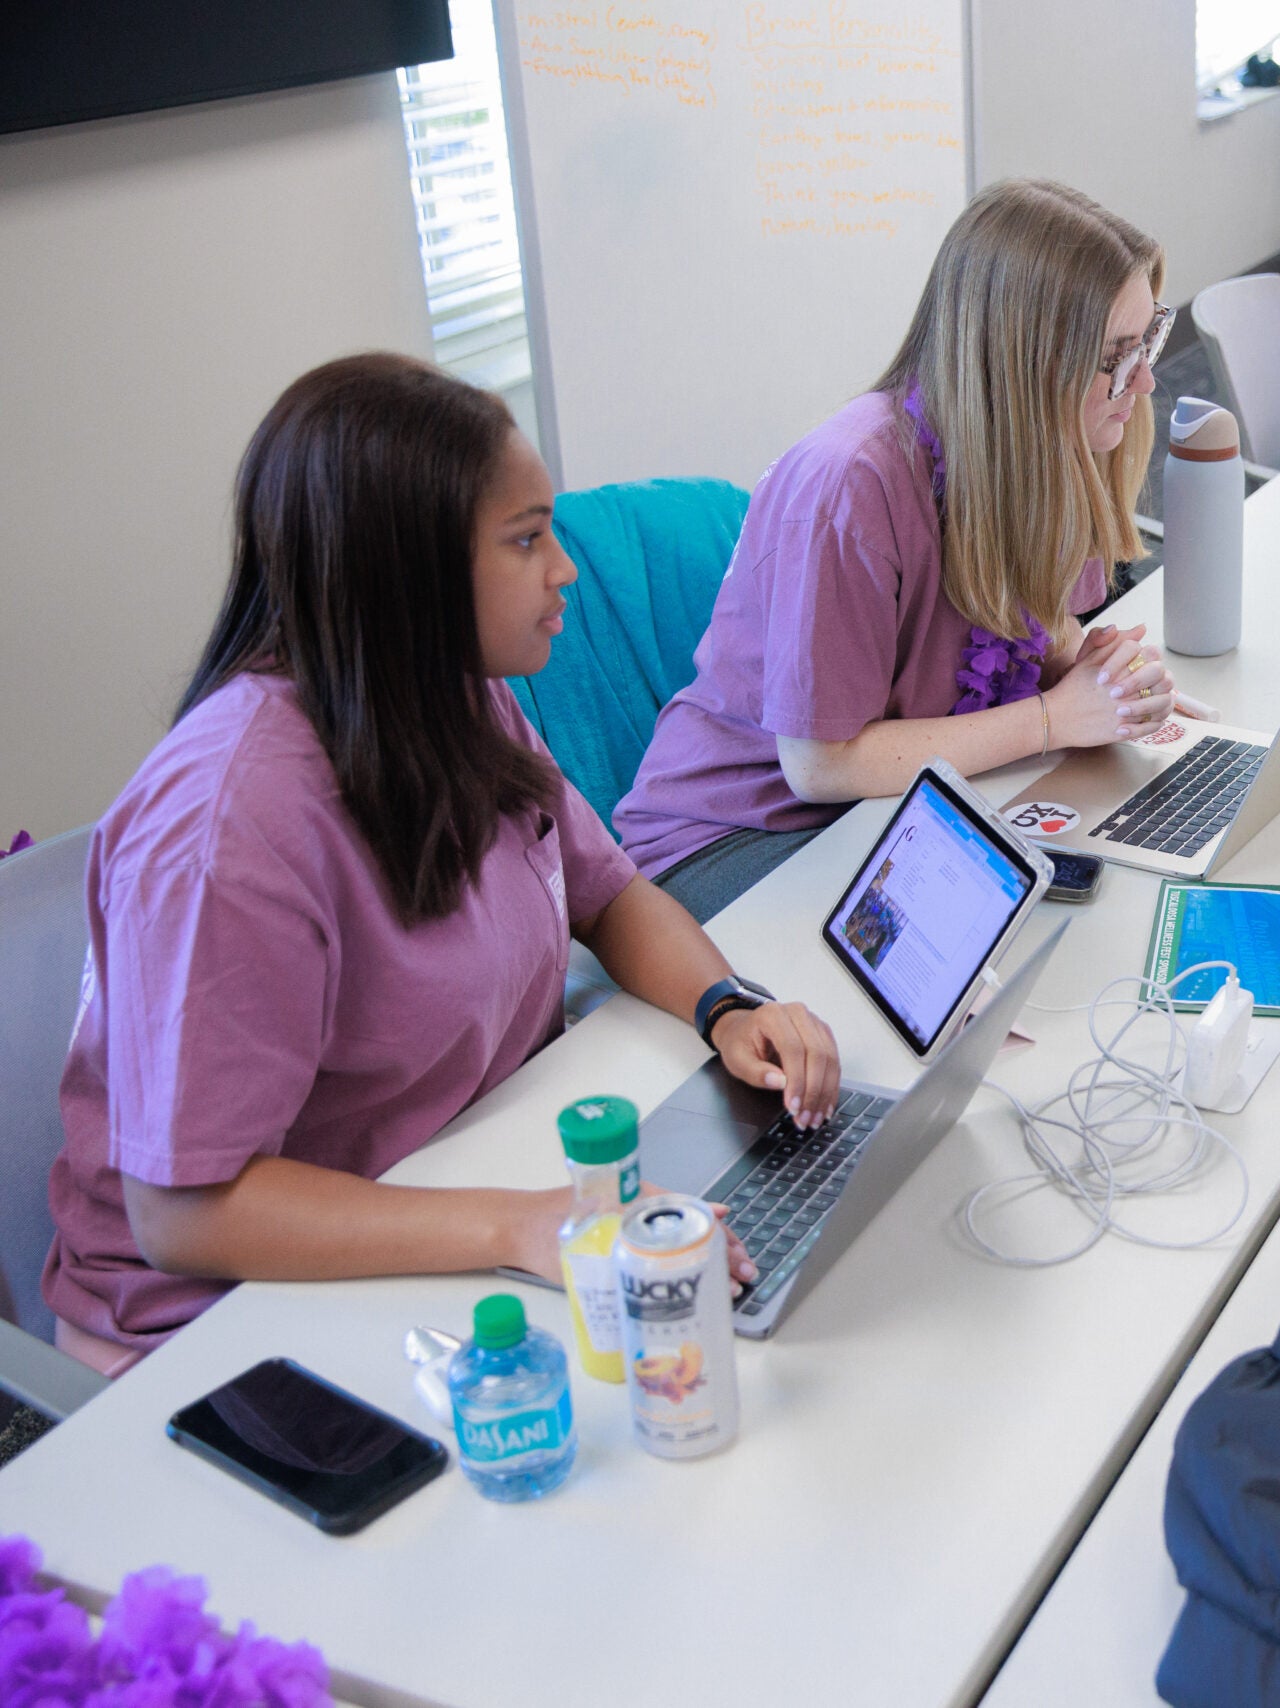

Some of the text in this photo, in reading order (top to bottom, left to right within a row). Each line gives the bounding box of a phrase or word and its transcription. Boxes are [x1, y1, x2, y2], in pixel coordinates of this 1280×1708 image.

[1166, 890, 1181, 921] TUSCALOOSA
[1162, 921, 1176, 947] WELLNESS
[1160, 946, 1172, 960] FEST
[620, 1269, 703, 1302] LUCKY
[463, 1418, 549, 1456] DASANI
